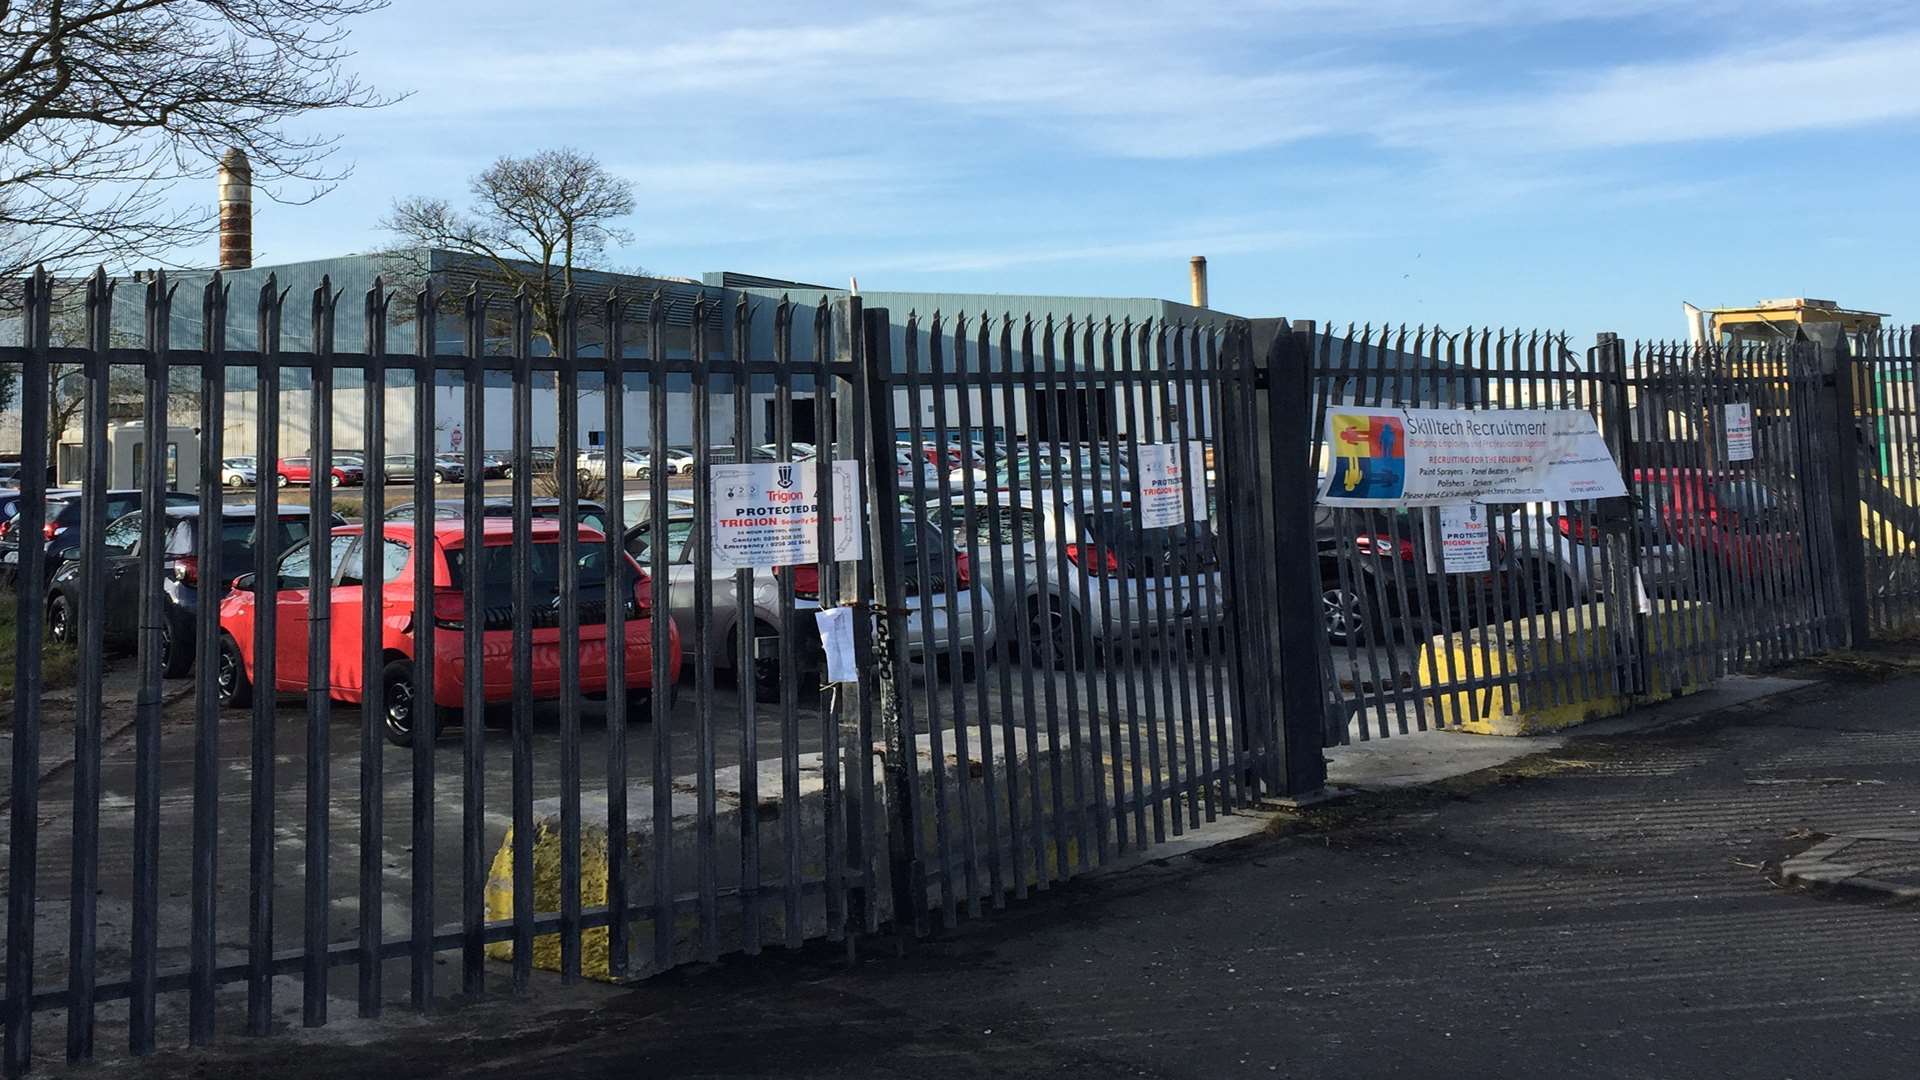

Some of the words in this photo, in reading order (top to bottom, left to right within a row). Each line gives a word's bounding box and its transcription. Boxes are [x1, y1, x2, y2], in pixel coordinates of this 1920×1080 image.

[1407, 418, 1464, 436] Skilltech
[1466, 420, 1547, 436] Recruitment
[1419, 468, 1436, 476] Paint
[1437, 468, 1464, 477] Sprayers
[766, 490, 804, 503] Trigion
[1403, 491, 1424, 499] Please
[736, 505, 810, 516] PROTECTED
[719, 518, 777, 527] TRIGION
[723, 542, 764, 550] Emergency
